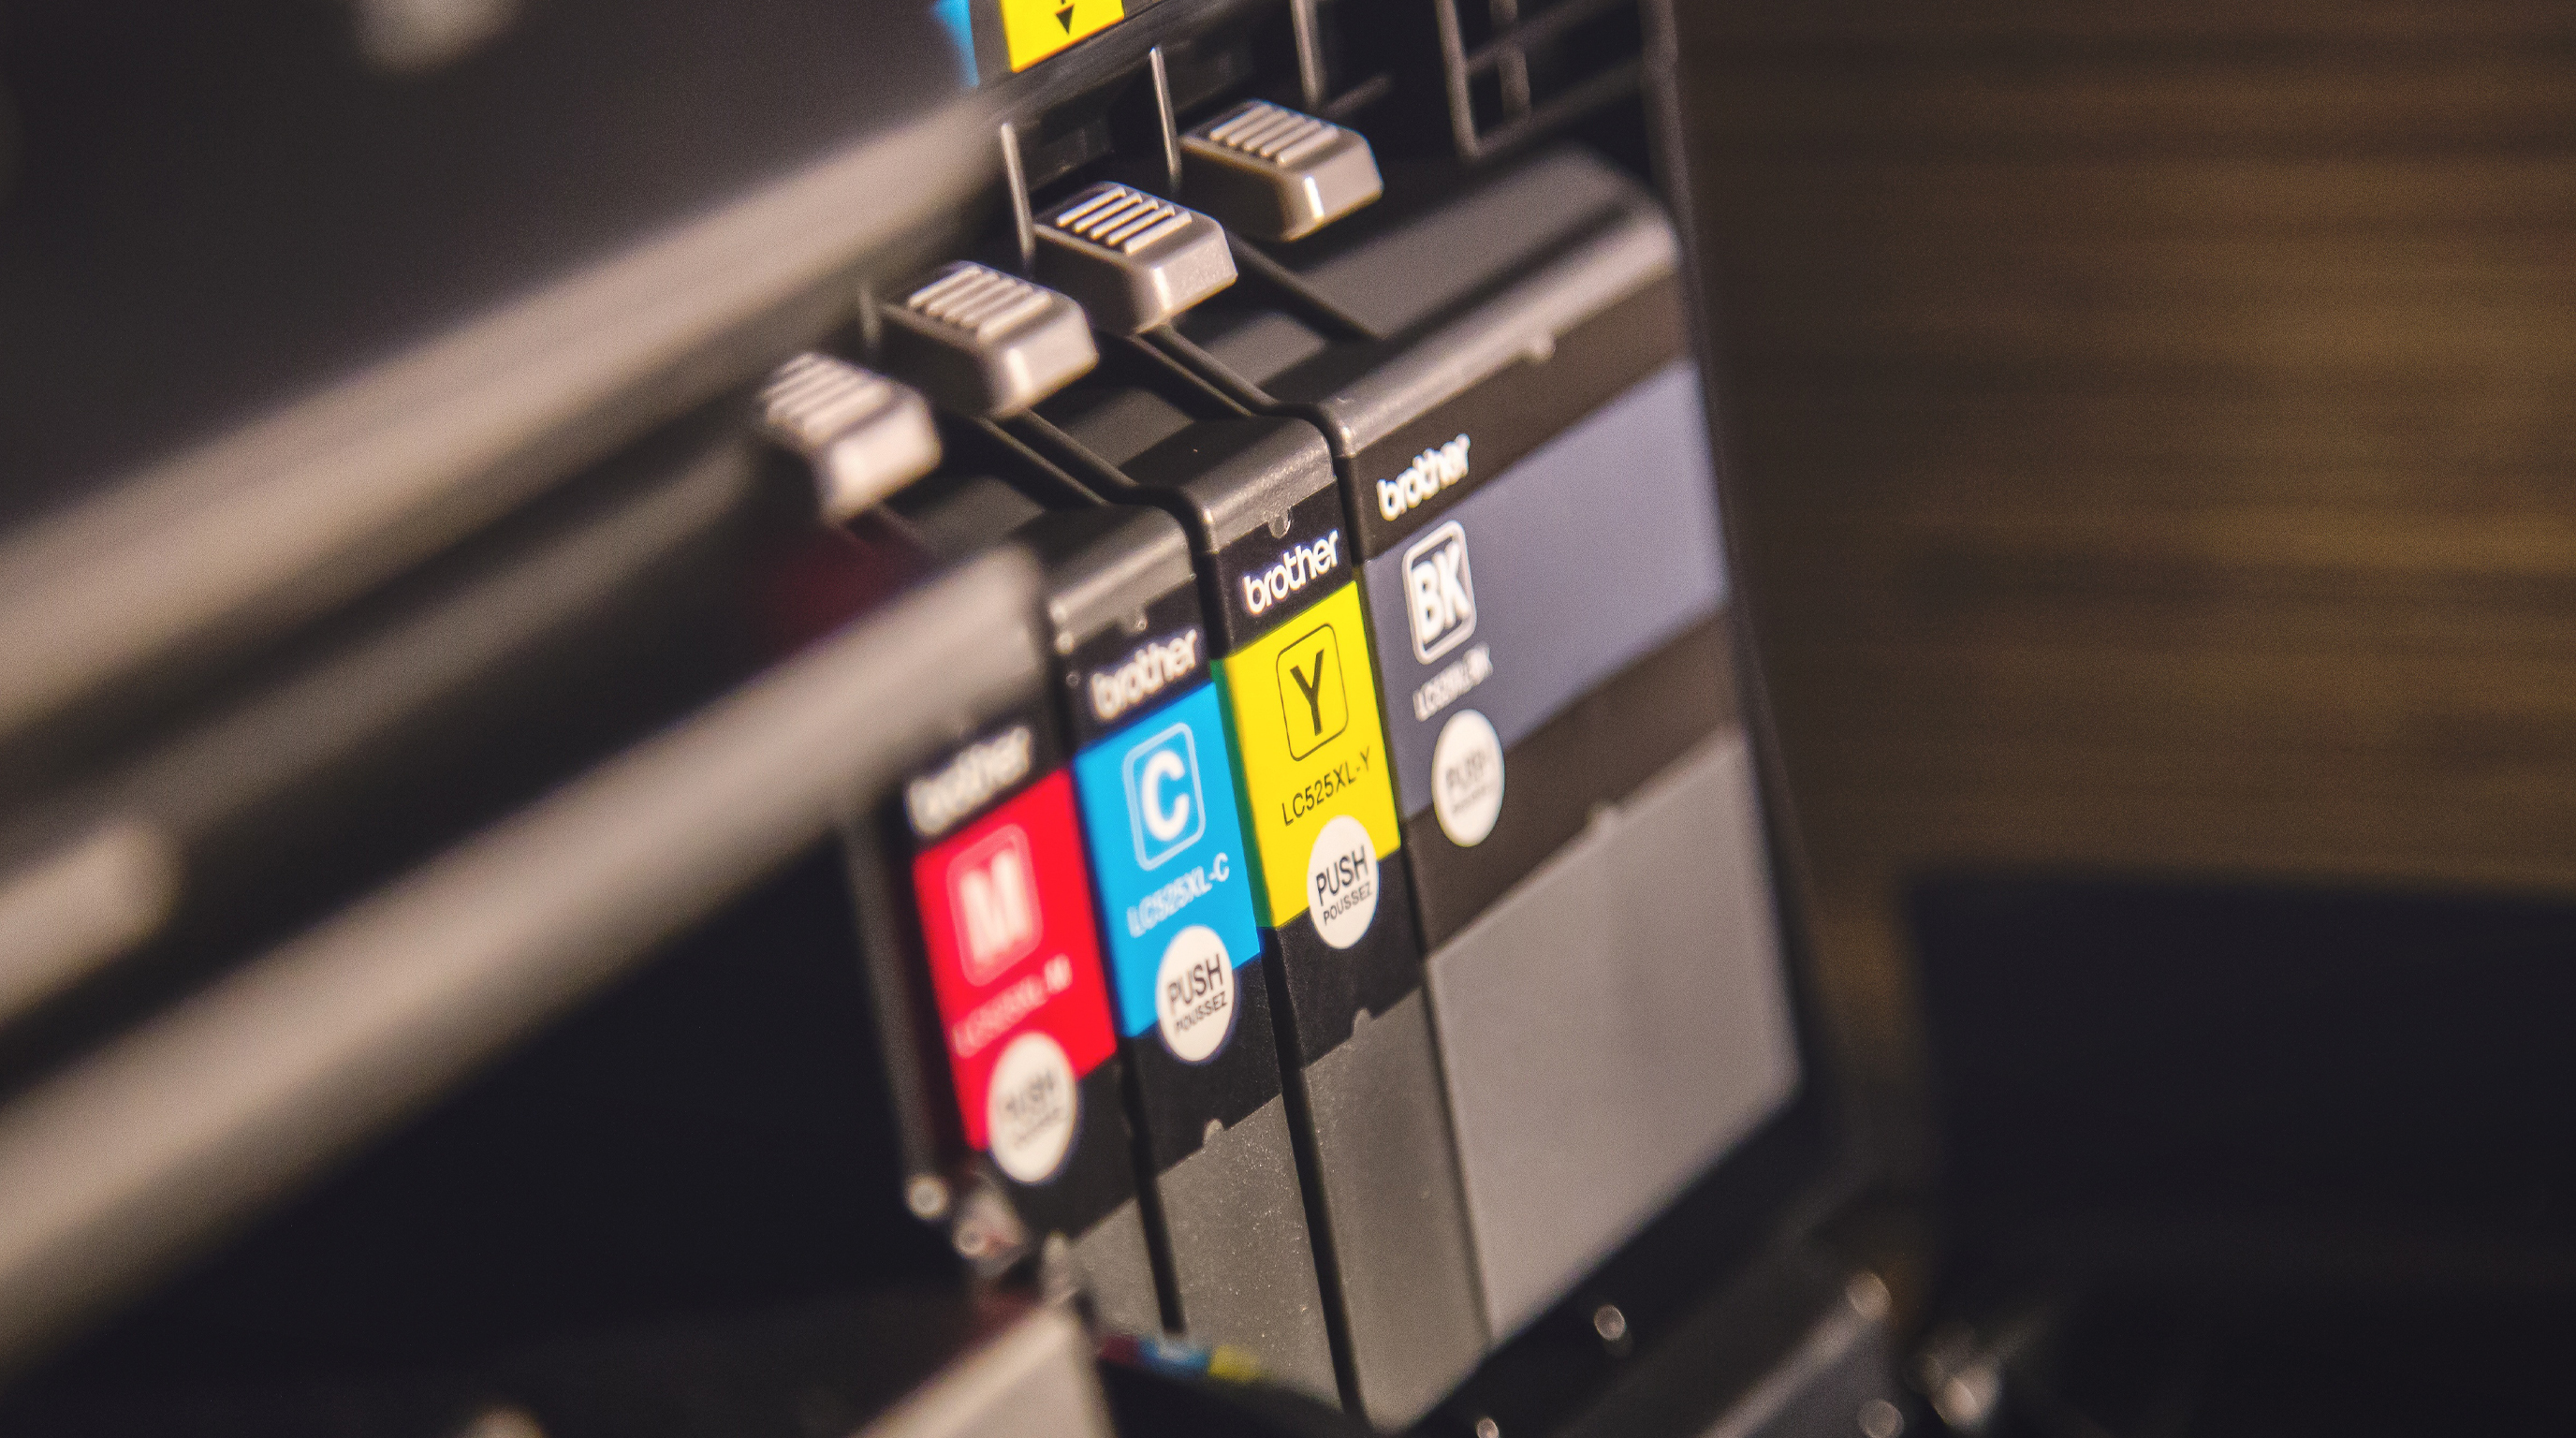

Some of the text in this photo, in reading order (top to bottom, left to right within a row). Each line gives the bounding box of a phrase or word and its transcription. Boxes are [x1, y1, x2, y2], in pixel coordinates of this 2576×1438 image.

[1376, 433, 1471, 521] brother
[1242, 529, 1339, 615] brother
[1412, 540, 1472, 644] BK
[1090, 628, 1197, 719] brother
[1289, 648, 1325, 737] Y
[1141, 749, 1190, 842] C
[1281, 746, 1370, 827] LC525XL-Y
[959, 846, 1032, 968] M
[1126, 852, 1230, 938] LC525XL-C
[1316, 845, 1369, 907] PUSH
[1323, 882, 1373, 926] POUSSEZ
[1168, 953, 1223, 1017] PUSH
[1176, 990, 1228, 1036] POUSSEZ
